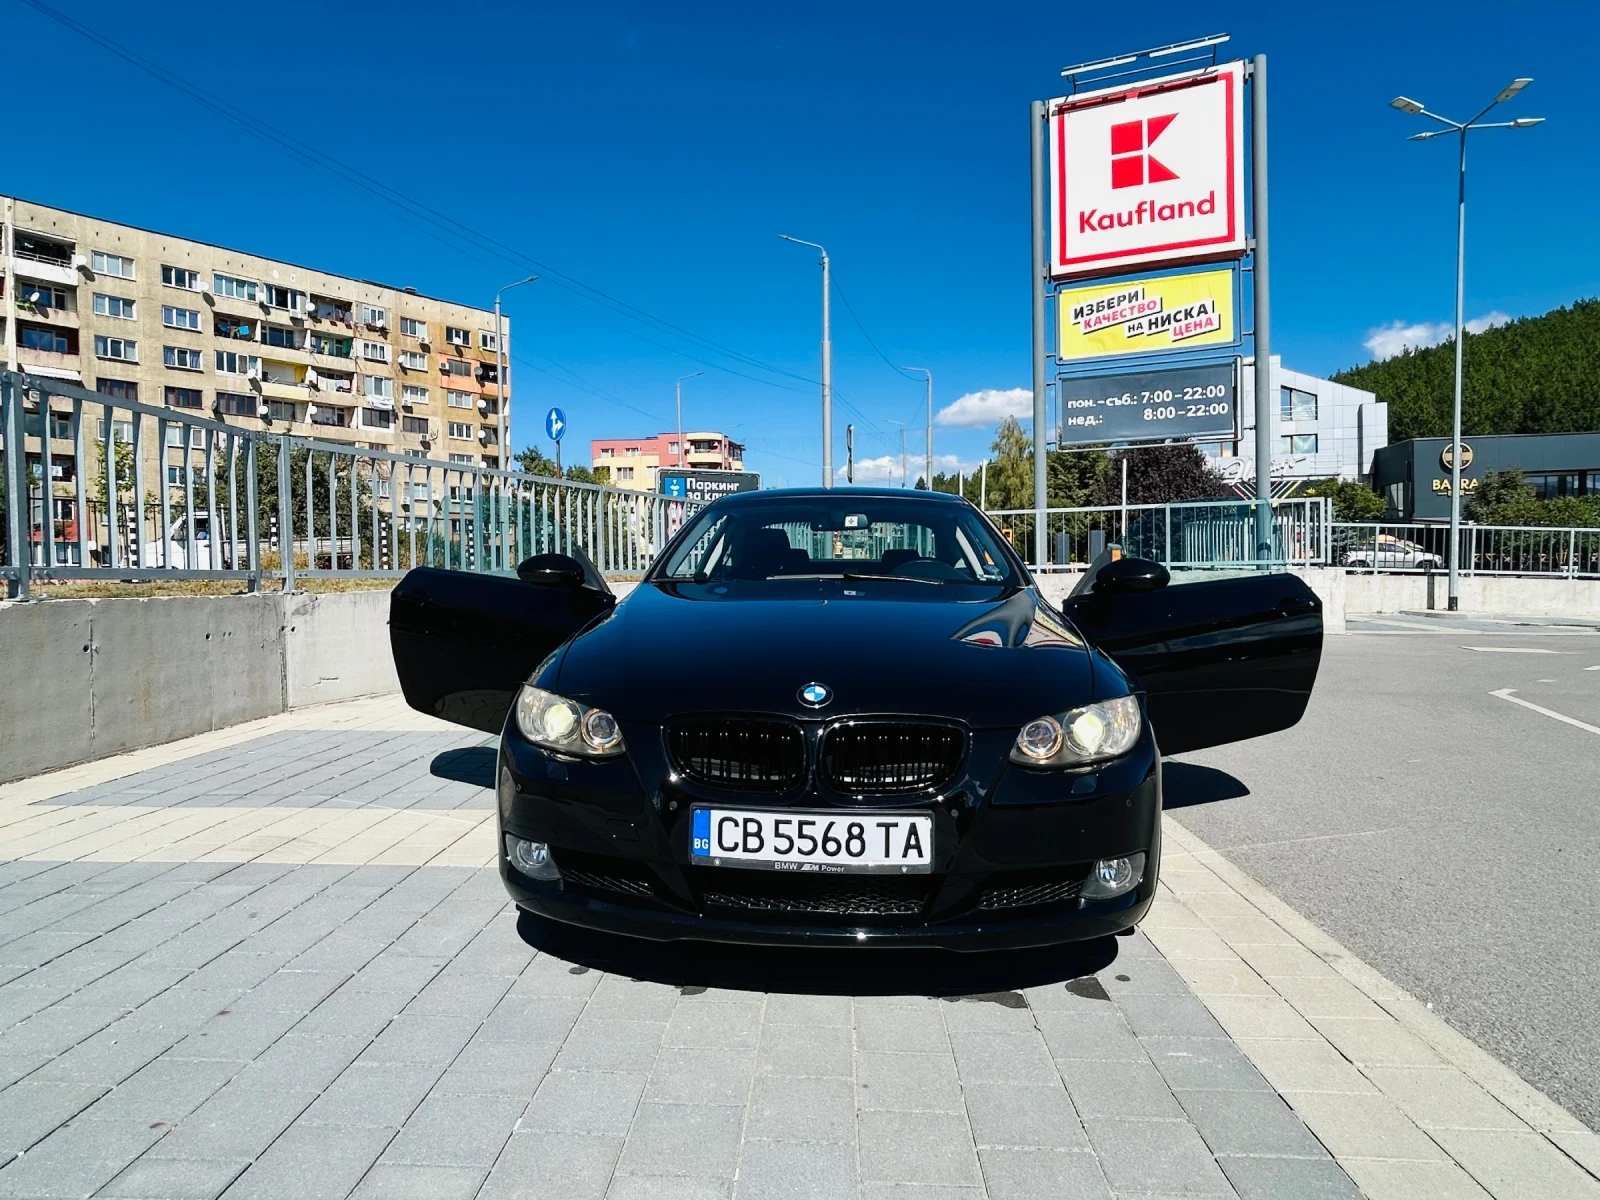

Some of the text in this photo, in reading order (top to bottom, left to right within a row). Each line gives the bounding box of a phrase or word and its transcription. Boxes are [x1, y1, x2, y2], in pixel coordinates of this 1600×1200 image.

[1079, 190, 1215, 233] Kaufland
[1073, 290, 1139, 320] ИЗБЕРИ
[1083, 300, 1157, 330] КАЧЕСТВО
[1127, 303, 1208, 333] НА НИСКА
[1173, 317, 1214, 337] ЦЕНА
[686, 477, 739, 493] Паркинг
[1432, 478, 1479, 490] BARA
[687, 491, 701, 501] за
[693, 837, 709, 849] BG
[717, 816, 924, 859] CB 5568 TA
[774, 861, 798, 870] BMW
[821, 864, 845, 873] Power
